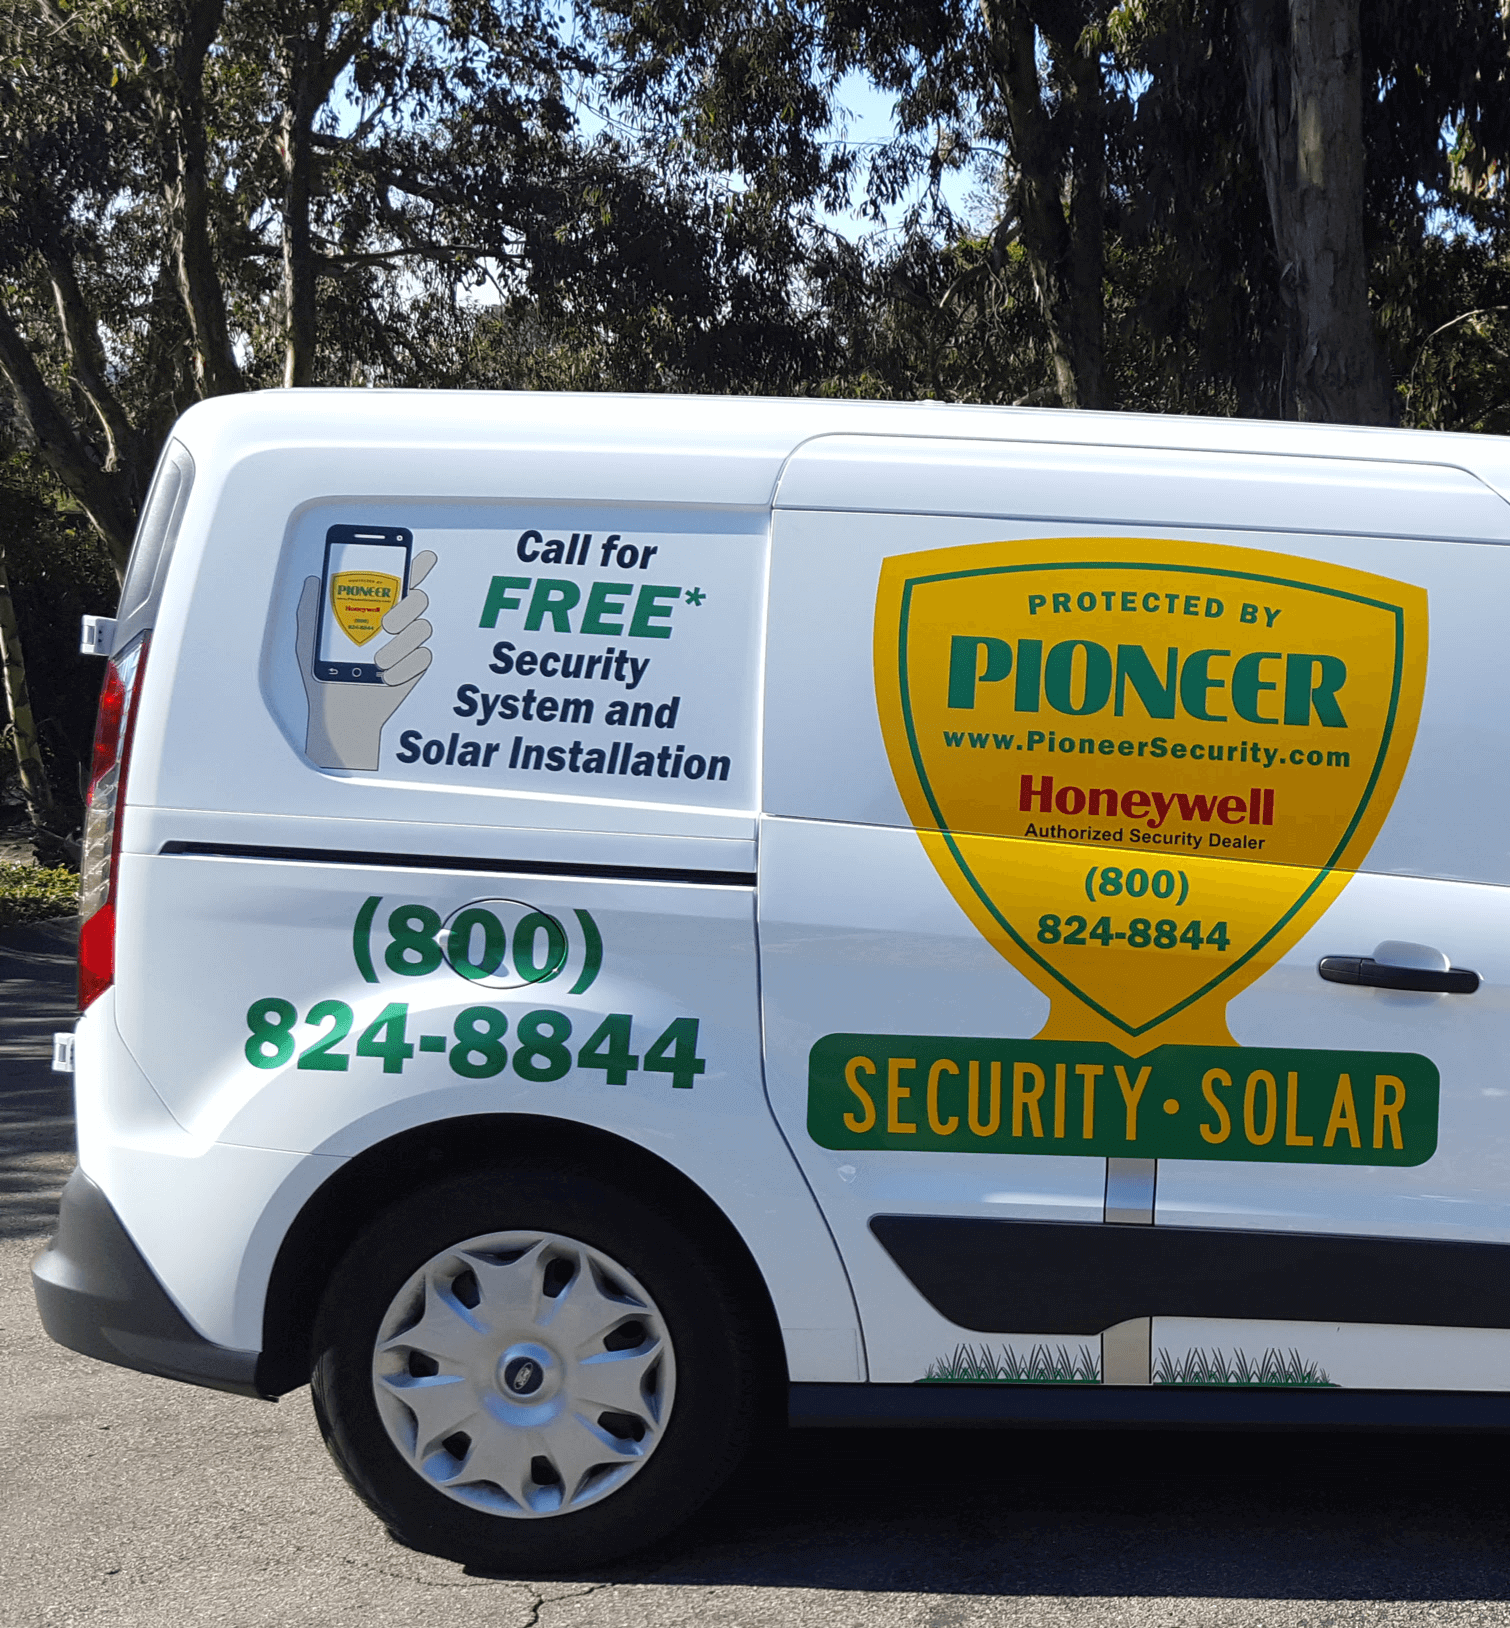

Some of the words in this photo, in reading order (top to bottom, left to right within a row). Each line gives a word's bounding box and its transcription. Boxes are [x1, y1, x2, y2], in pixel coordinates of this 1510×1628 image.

[516, 529, 593, 566] Call
[599, 534, 658, 570] for
[337, 584, 392, 598] PIONEER
[1028, 590, 1225, 619] PROTECTED
[1239, 603, 1283, 628] BY
[488, 641, 651, 691] Security
[947, 635, 1348, 728] PIONEER
[452, 683, 595, 727] System
[604, 696, 681, 729] and
[395, 729, 502, 768] Solar
[508, 735, 732, 783] Installation
[942, 729, 1351, 769] www.PioneerSecurity.com
[1018, 774, 1275, 829] Honeywell
[1024, 822, 1124, 845] Authorized
[1129, 828, 1204, 851] Security
[1208, 833, 1266, 852] Dealer
[1085, 866, 1190, 906] (800)
[352, 895, 604, 995] (800)
[1036, 914, 1231, 952] 824-8844
[244, 997, 706, 1089] 824-8844
[843, 1055, 1153, 1142] SECURITY
[1199, 1066, 1408, 1150] SOLAR
